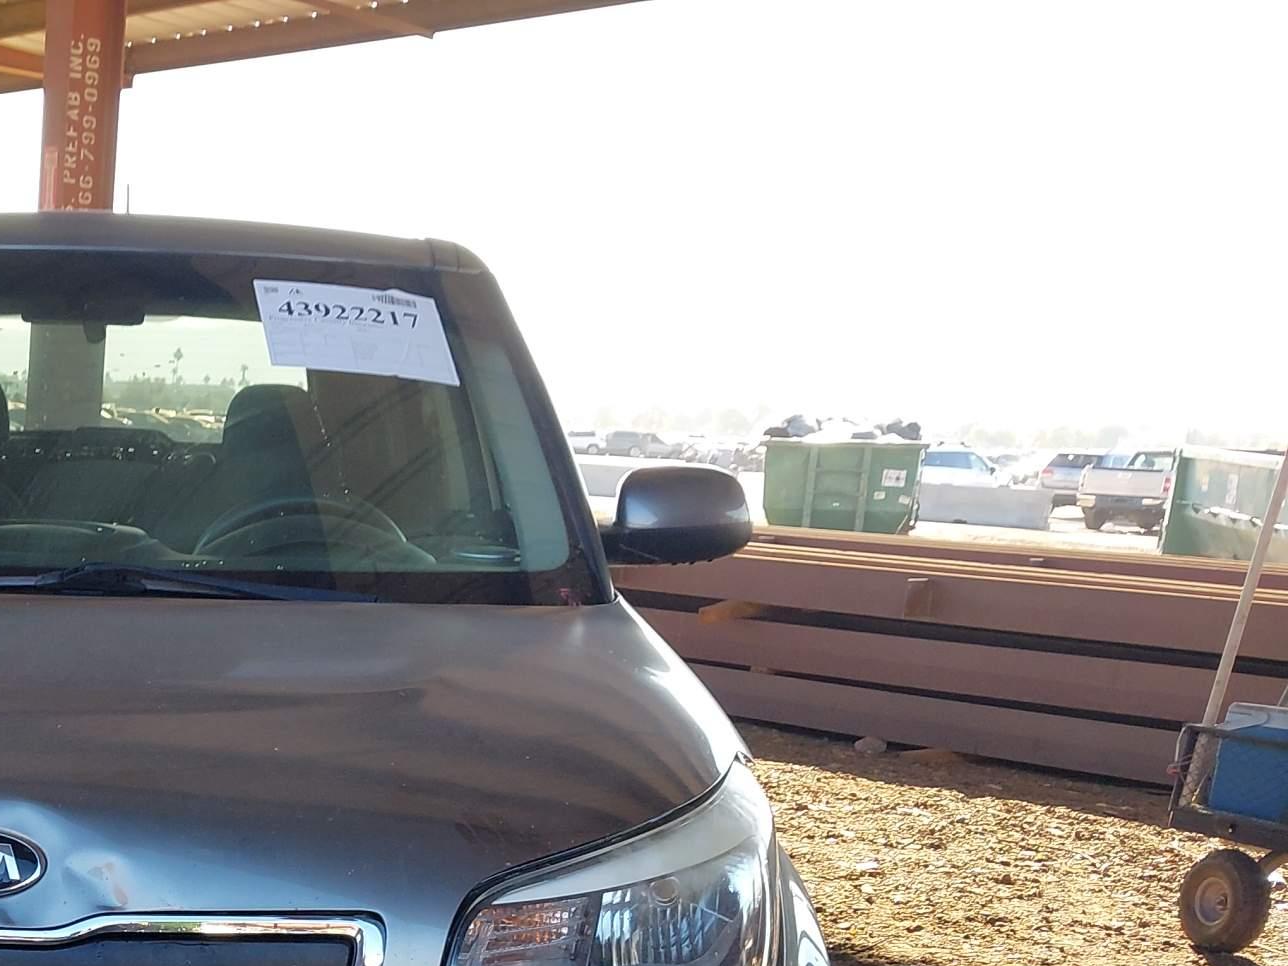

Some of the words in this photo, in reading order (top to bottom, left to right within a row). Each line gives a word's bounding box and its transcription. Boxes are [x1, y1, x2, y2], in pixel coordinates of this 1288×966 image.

[69, 33, 85, 79] INC.
[63, 92, 80, 184] PREFAB
[78, 37, 101, 211] 66-799-0969
[278, 300, 418, 329] 43922217
